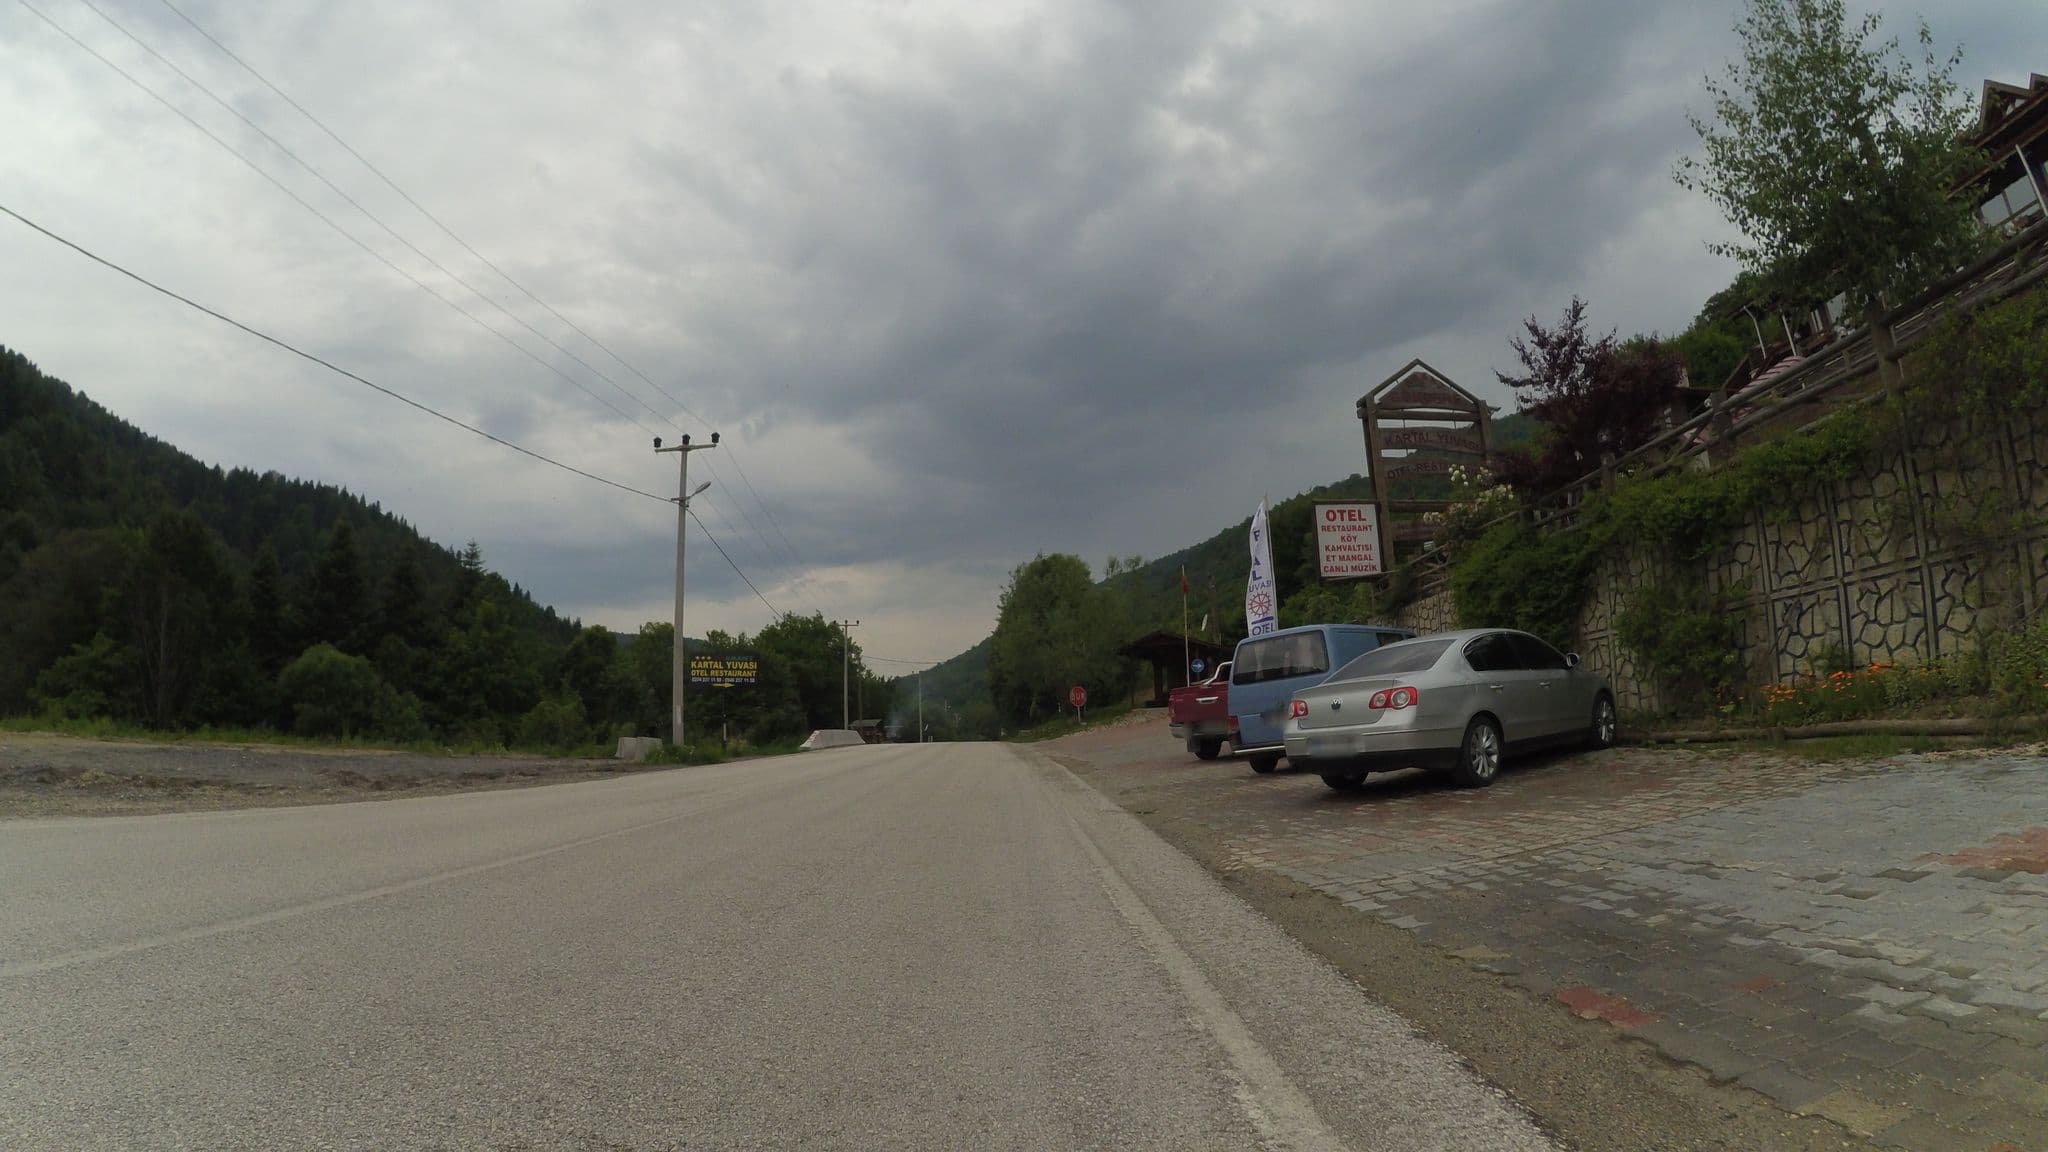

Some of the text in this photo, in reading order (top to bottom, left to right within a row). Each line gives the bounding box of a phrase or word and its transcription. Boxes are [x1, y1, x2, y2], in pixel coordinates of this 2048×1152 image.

[1325, 509, 1367, 522] OTEL
[1340, 534, 1358, 543] KÖY
[1325, 544, 1373, 552] KAHVALTISI
[1338, 554, 1374, 562] MANGAL
[1323, 565, 1349, 573] CANLI
[1251, 622, 1276, 636] OTEL
[691, 661, 757, 669] KARTAL YUVASI
